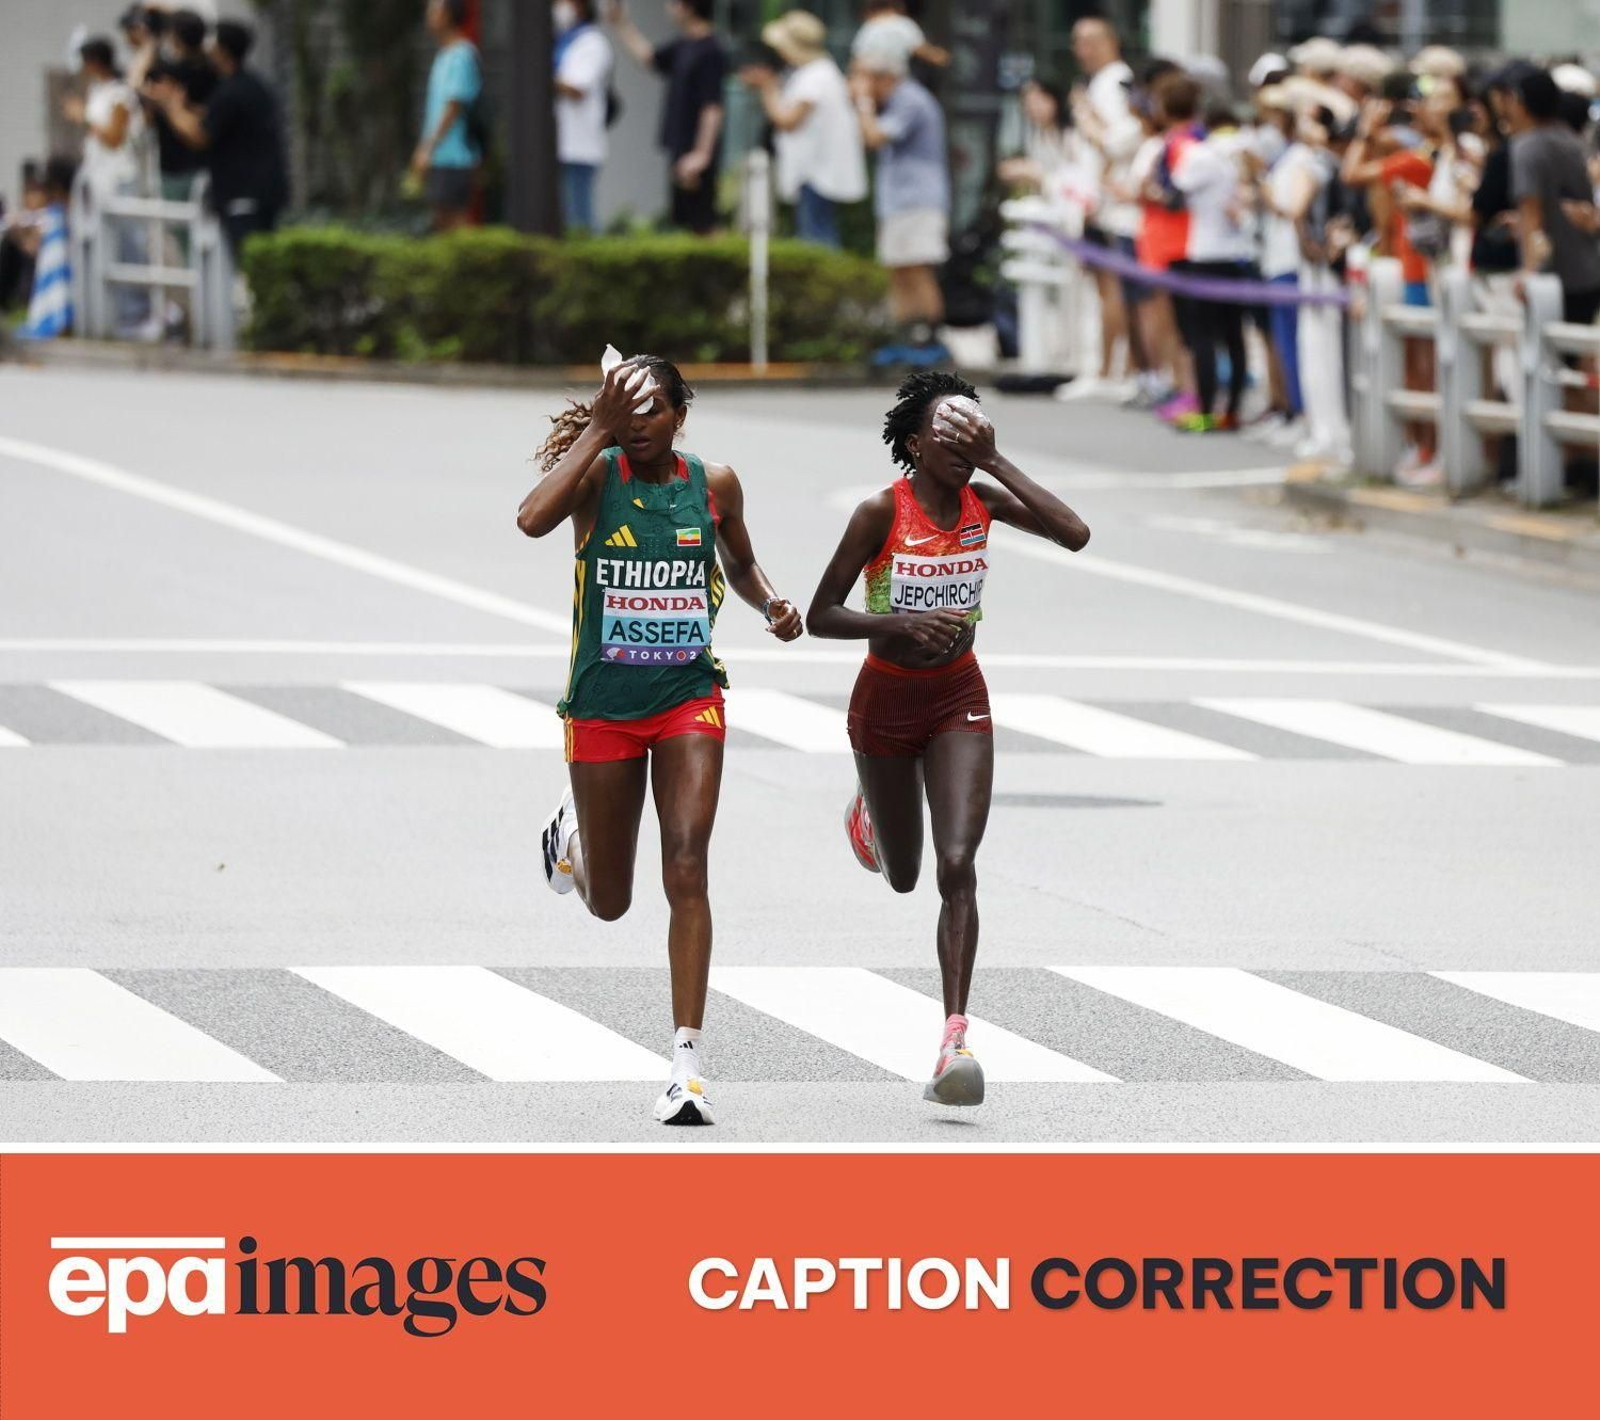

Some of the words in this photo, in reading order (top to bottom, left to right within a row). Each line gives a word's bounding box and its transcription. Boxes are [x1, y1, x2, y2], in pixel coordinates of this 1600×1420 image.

[596, 557, 706, 588] ETHIOPIA
[895, 557, 988, 577] HONDA
[606, 594, 706, 611] HONDA
[608, 620, 705, 644] ASSEFA
